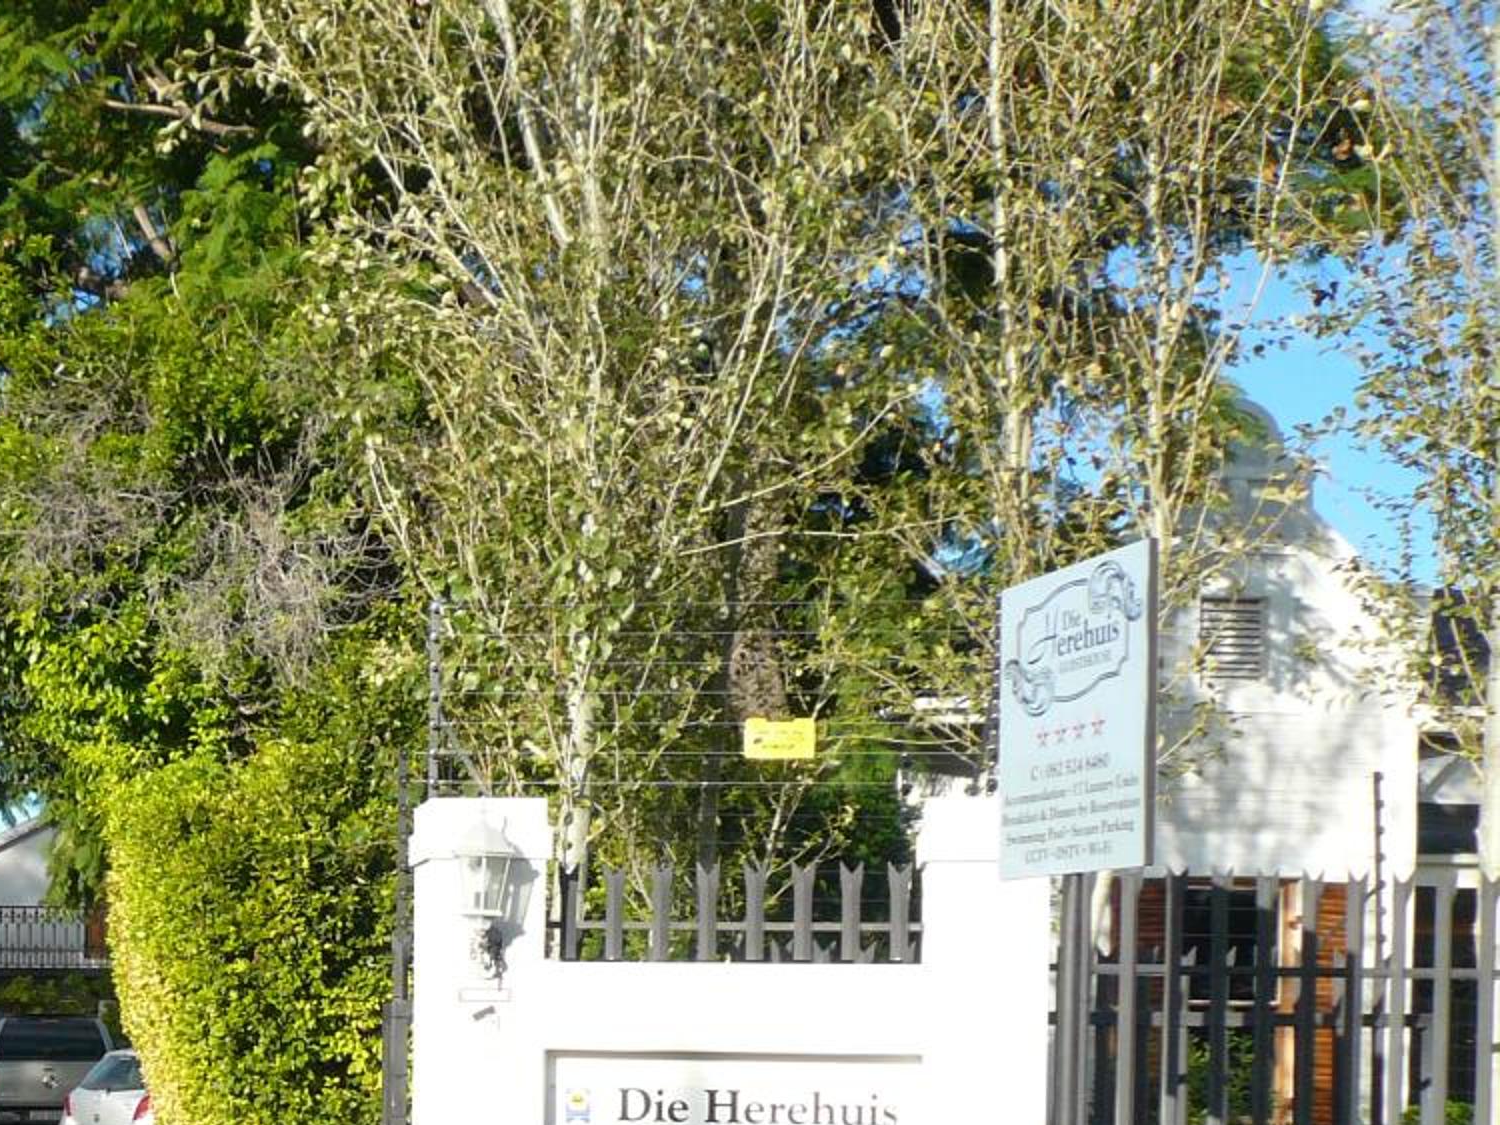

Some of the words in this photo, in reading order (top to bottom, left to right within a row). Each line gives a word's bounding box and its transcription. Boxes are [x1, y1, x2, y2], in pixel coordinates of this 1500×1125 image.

[1028, 609, 1120, 665] Herehuis
[1061, 609, 1081, 631] Die
[618, 1087, 690, 1123] Die
